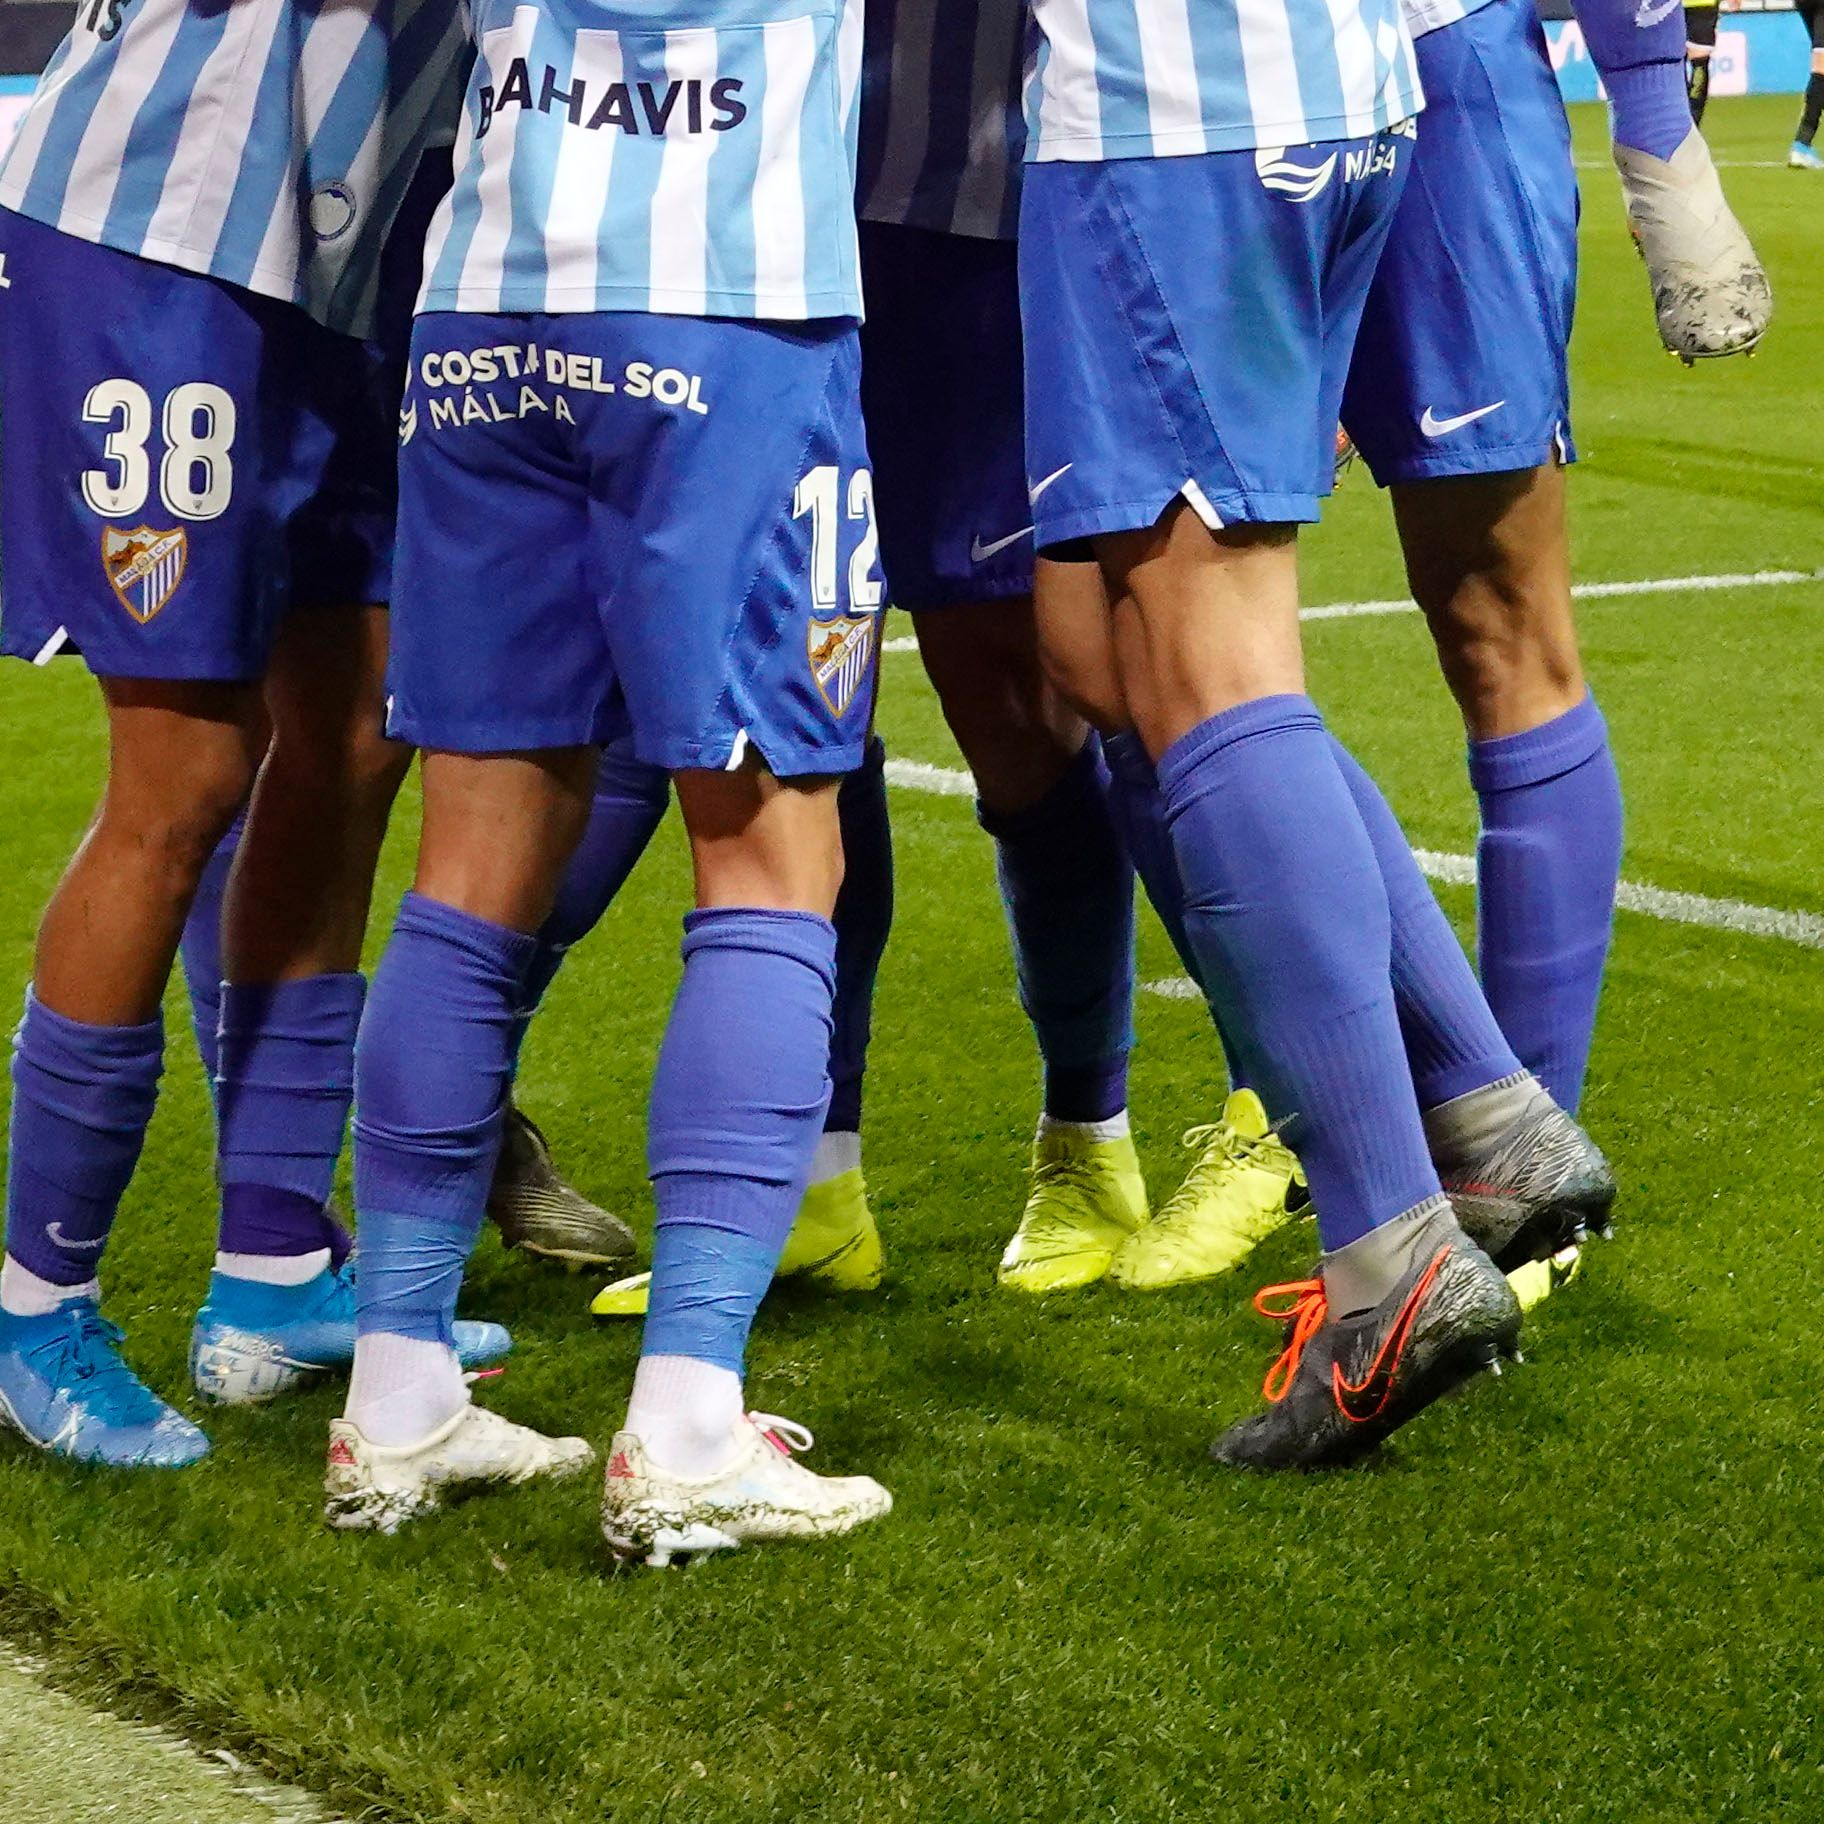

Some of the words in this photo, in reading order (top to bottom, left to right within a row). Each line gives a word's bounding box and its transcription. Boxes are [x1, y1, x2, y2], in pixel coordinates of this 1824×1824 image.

[427, 384, 577, 431] MÁLAA
[545, 349, 616, 394] DEL
[622, 362, 710, 416] SOL
[80, 378, 238, 522] 38
[792, 465, 883, 612] 12
